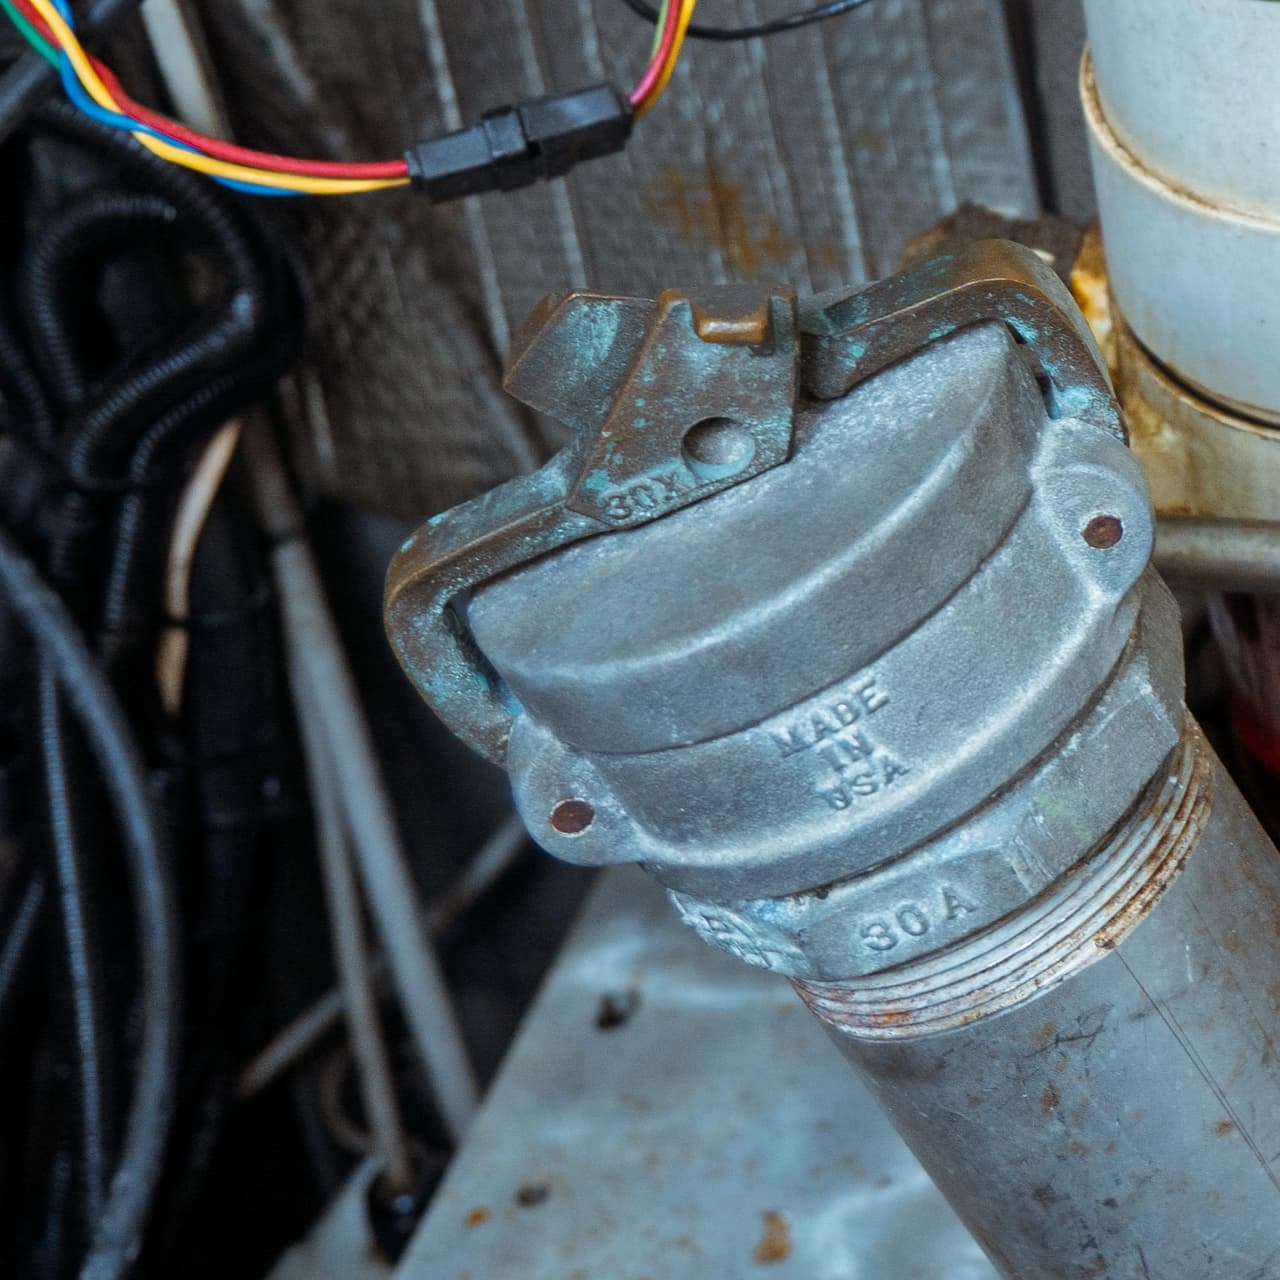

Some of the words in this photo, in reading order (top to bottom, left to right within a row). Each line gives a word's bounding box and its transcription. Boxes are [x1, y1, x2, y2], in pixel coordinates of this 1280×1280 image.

[772, 677, 891, 759] MADE
[816, 729, 875, 773] IN
[810, 755, 912, 811] USA
